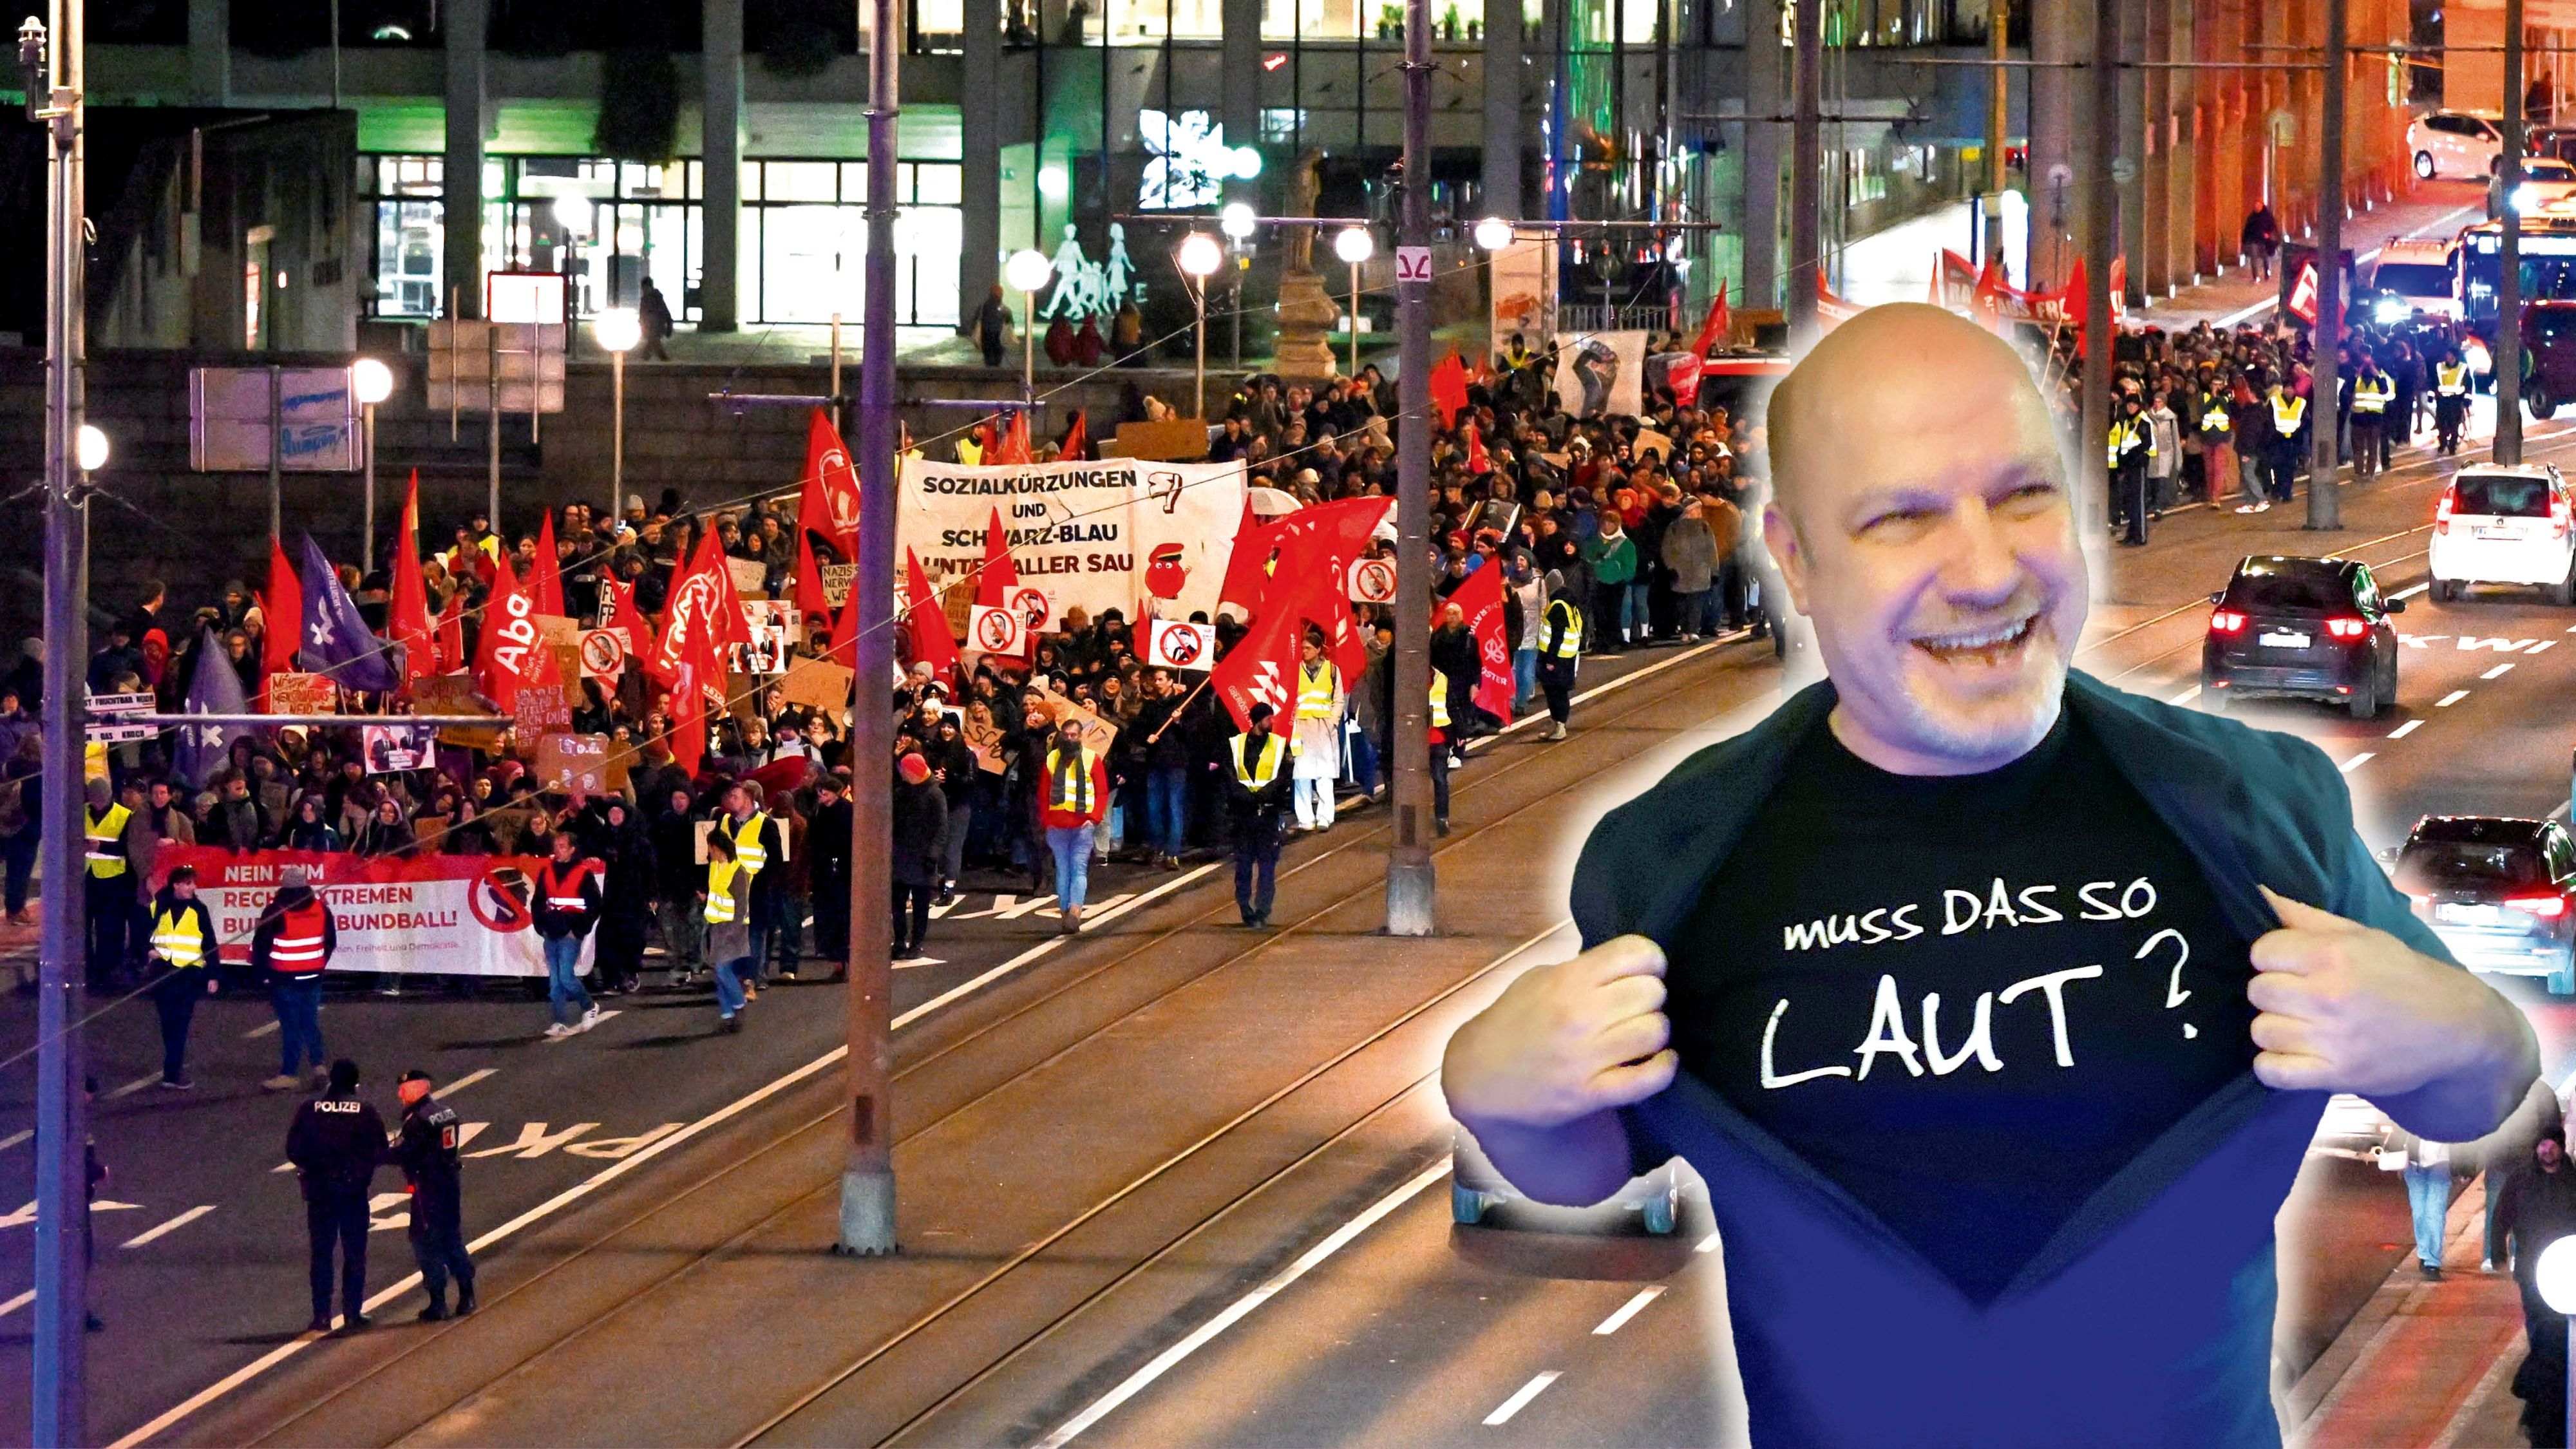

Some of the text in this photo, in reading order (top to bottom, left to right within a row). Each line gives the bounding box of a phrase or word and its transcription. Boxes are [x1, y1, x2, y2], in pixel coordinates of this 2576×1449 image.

[923, 469, 1137, 495] SOZIALKÜRZUNGEN
[1012, 502, 1047, 518] UND
[823, 566, 853, 576] NAZIS
[923, 553, 1134, 575] UNTE ALLER SAU
[494, 593, 535, 676] Abo
[225, 863, 325, 882] NEIN ZM
[223, 887, 413, 908] RECHXTREMEN
[1942, 877, 2063, 936] DAS
[2079, 876, 2157, 920] SO
[223, 910, 458, 934] BUBUNDBALL!
[314, 1101, 361, 1113] POLIZEI
